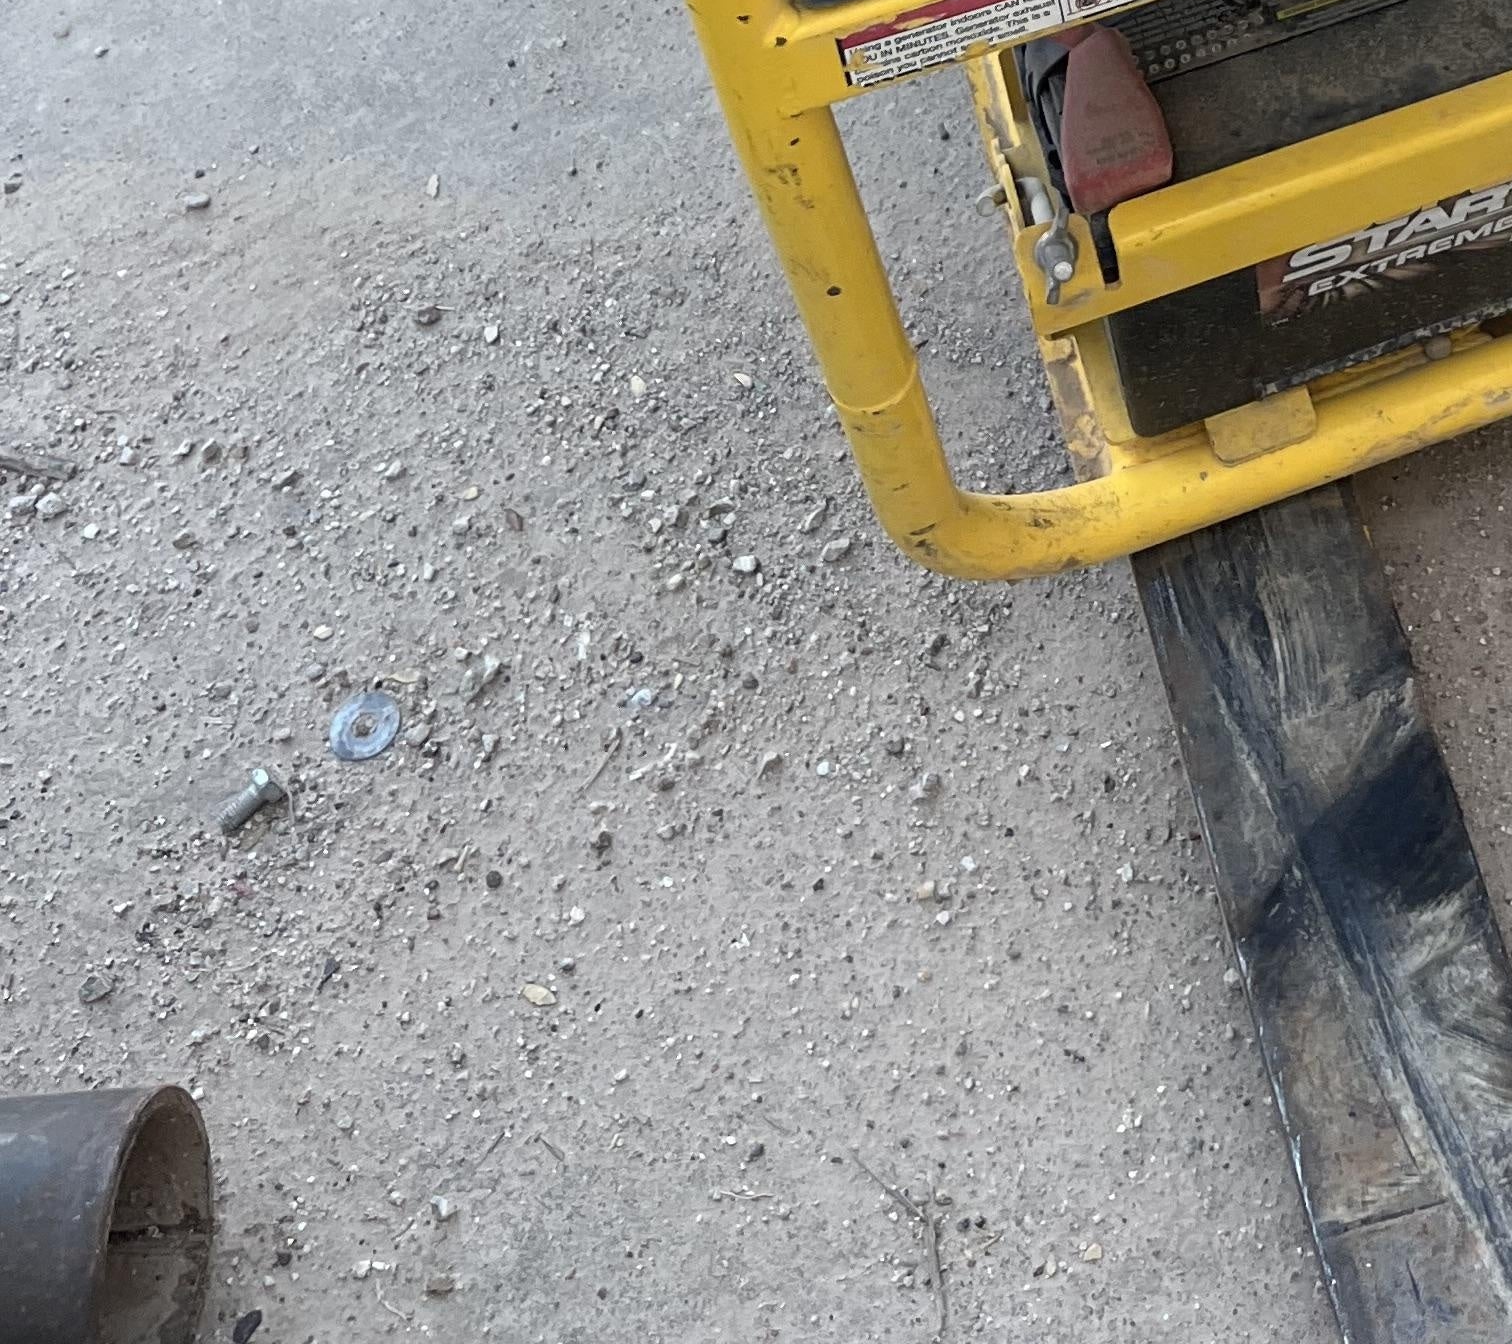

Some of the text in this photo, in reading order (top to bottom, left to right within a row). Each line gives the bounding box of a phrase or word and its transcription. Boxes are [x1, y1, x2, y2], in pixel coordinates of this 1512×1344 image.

[879, 47, 892, 58] IN
[895, 31, 950, 51] MINUTES.
[954, 12, 1009, 33] Generator
[894, 22, 947, 42] generator
[950, 7, 991, 25] indoors
[994, 0, 1019, 12] CAN
[904, 43, 942, 60] carbon
[945, 25, 1001, 46] monoxide.
[1006, 15, 1027, 27] This
[856, 66, 893, 83] poison
[897, 59, 916, 71] you
[919, 46, 957, 64] cannot
